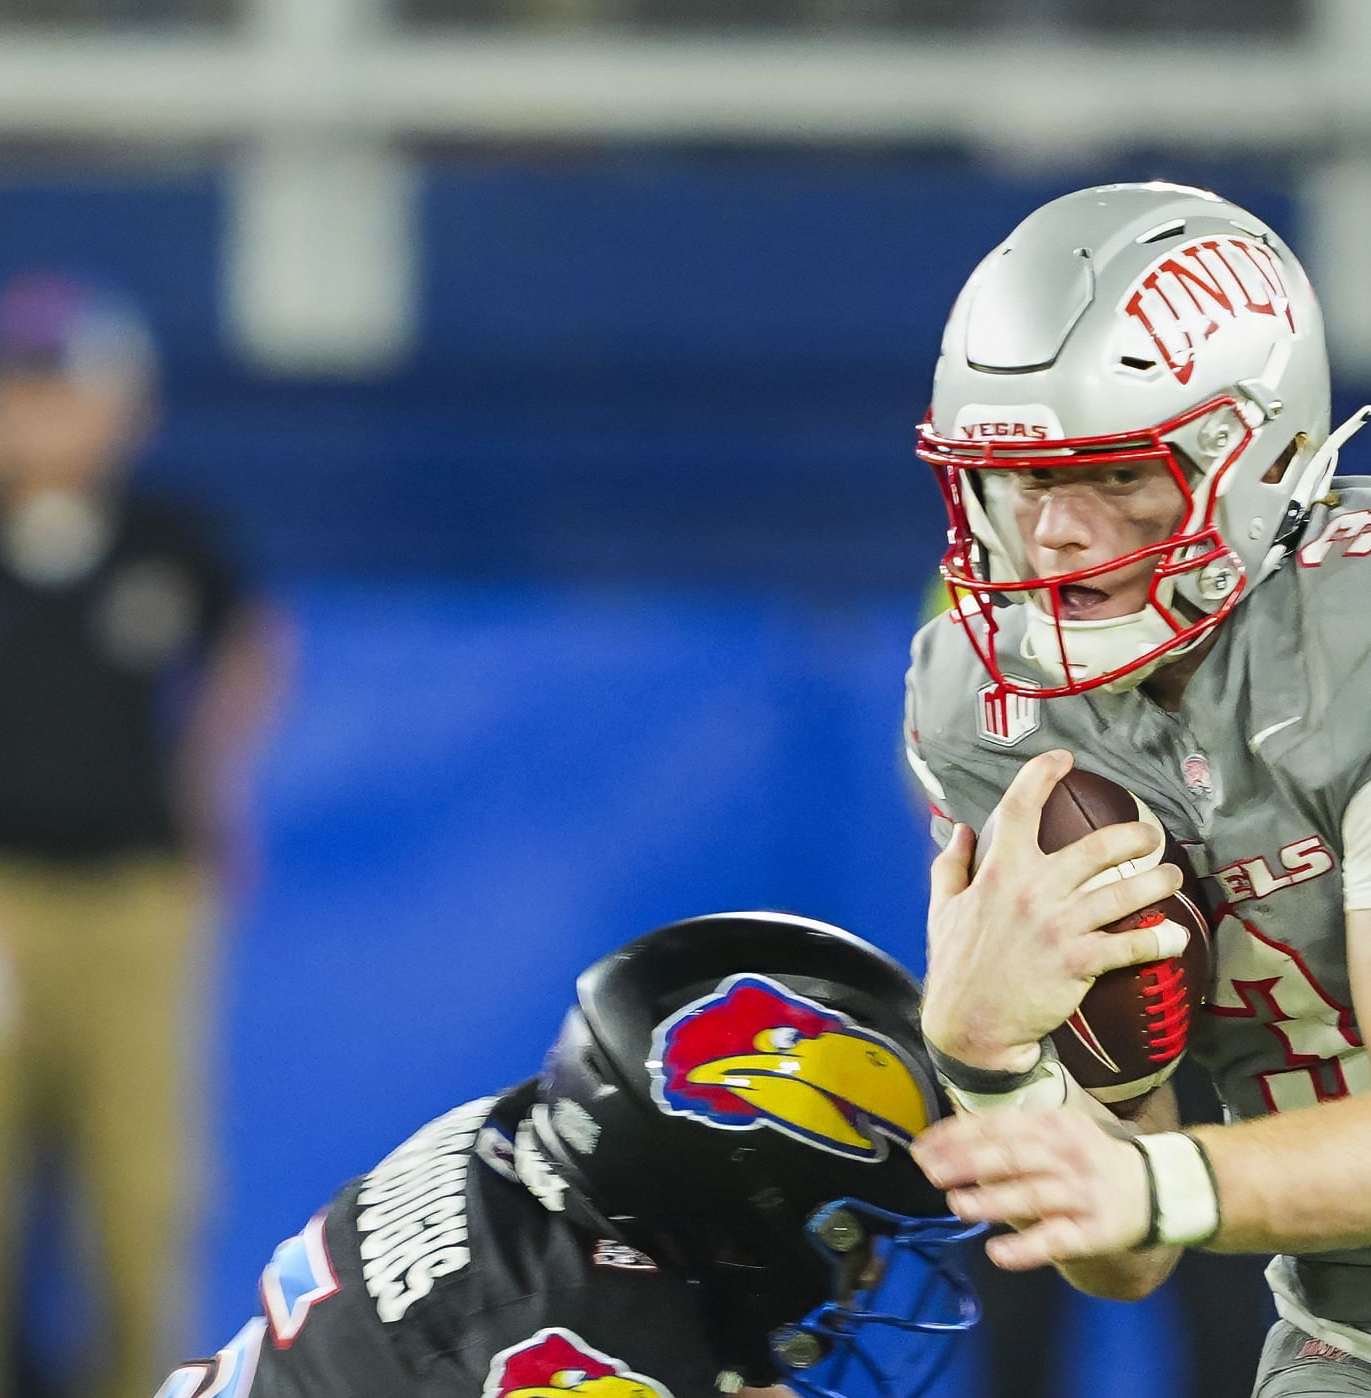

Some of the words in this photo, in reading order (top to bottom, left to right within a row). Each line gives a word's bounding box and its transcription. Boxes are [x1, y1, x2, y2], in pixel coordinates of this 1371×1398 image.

[1124, 238, 1297, 386] UNLV
[961, 422, 1048, 440] VEGAS
[1180, 834, 1335, 904] ELS
